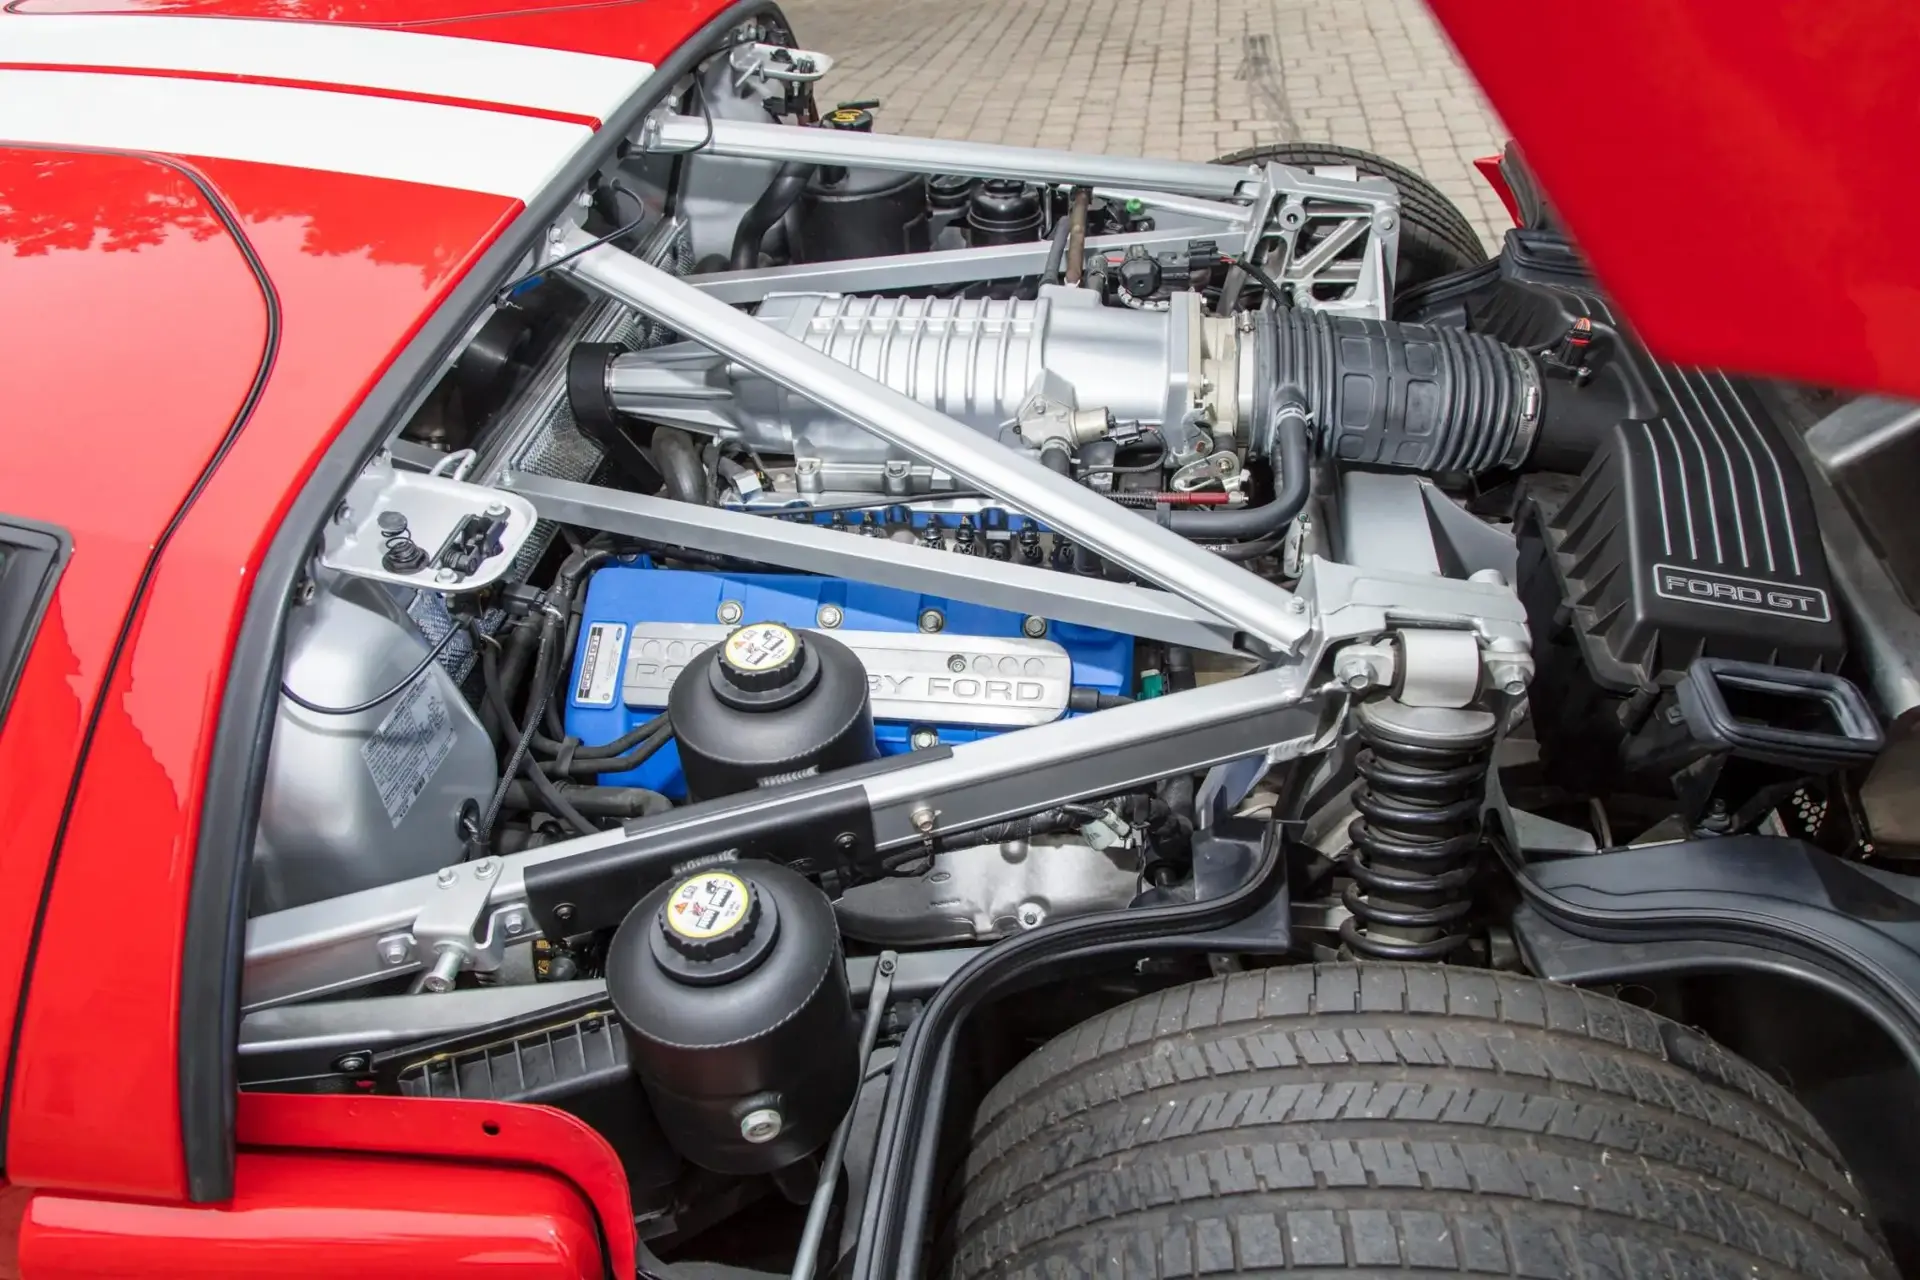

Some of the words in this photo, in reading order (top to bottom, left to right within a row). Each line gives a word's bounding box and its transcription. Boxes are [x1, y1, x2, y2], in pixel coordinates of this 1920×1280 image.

[1666, 575, 1762, 603] FORD
[1767, 591, 1816, 612] GT
[927, 677, 1045, 701] FORD
